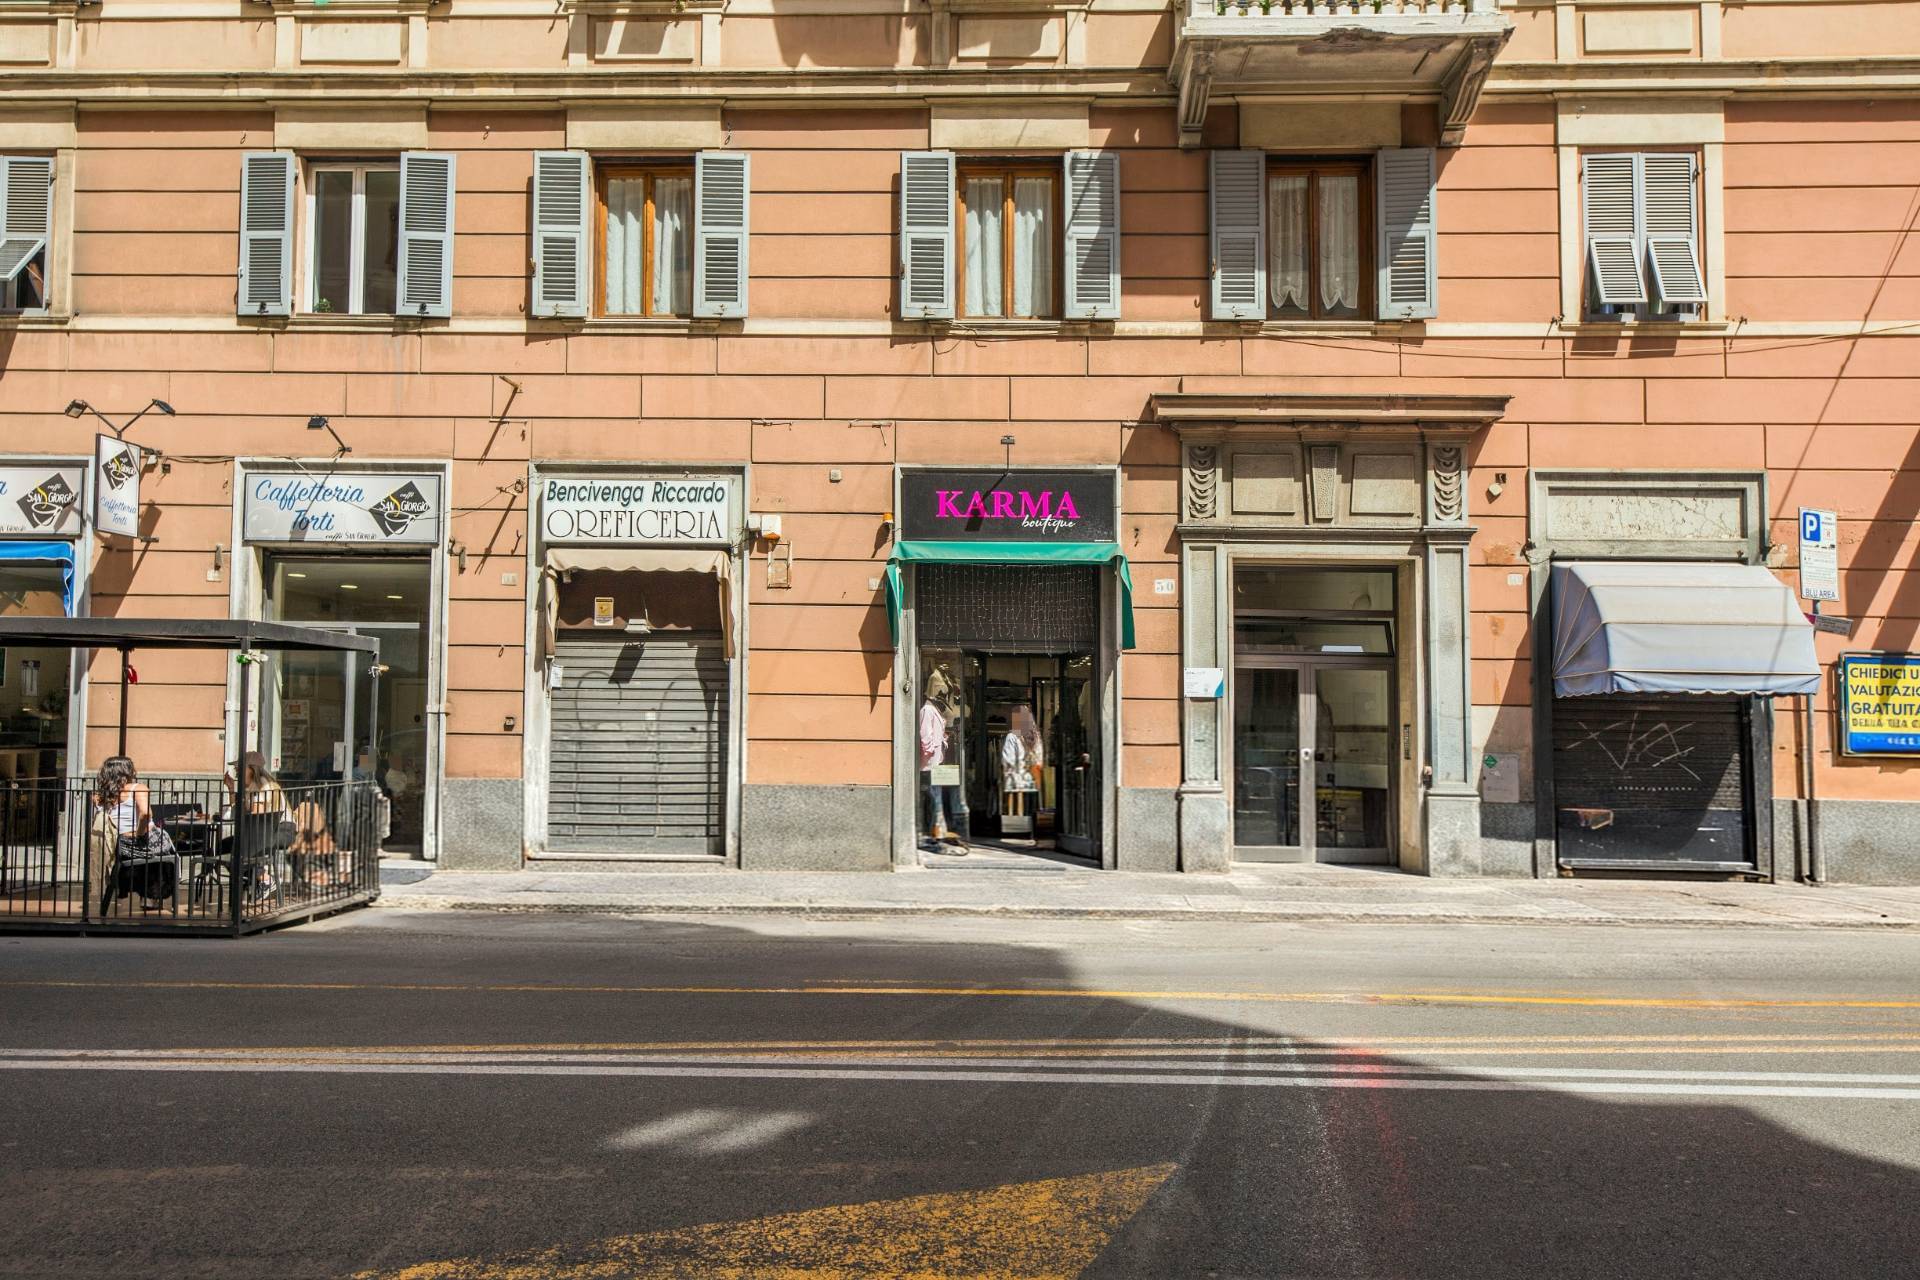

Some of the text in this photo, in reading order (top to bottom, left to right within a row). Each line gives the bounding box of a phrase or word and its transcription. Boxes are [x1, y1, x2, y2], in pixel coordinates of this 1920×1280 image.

[100, 496, 137, 513] Caffetteria
[256, 479, 364, 510] Caffetteria
[381, 498, 395, 511] SAN
[547, 481, 725, 507] Bencivenga Riccardo
[936, 490, 1081, 518] KARMA
[293, 509, 335, 531] Torti
[547, 509, 723, 539] OREFICERIA
[1021, 514, 1076, 535] boutique
[1805, 515, 1818, 539] P
[1805, 588, 1836, 599] BLU AREA
[1850, 667, 1906, 679] CHIEDICI
